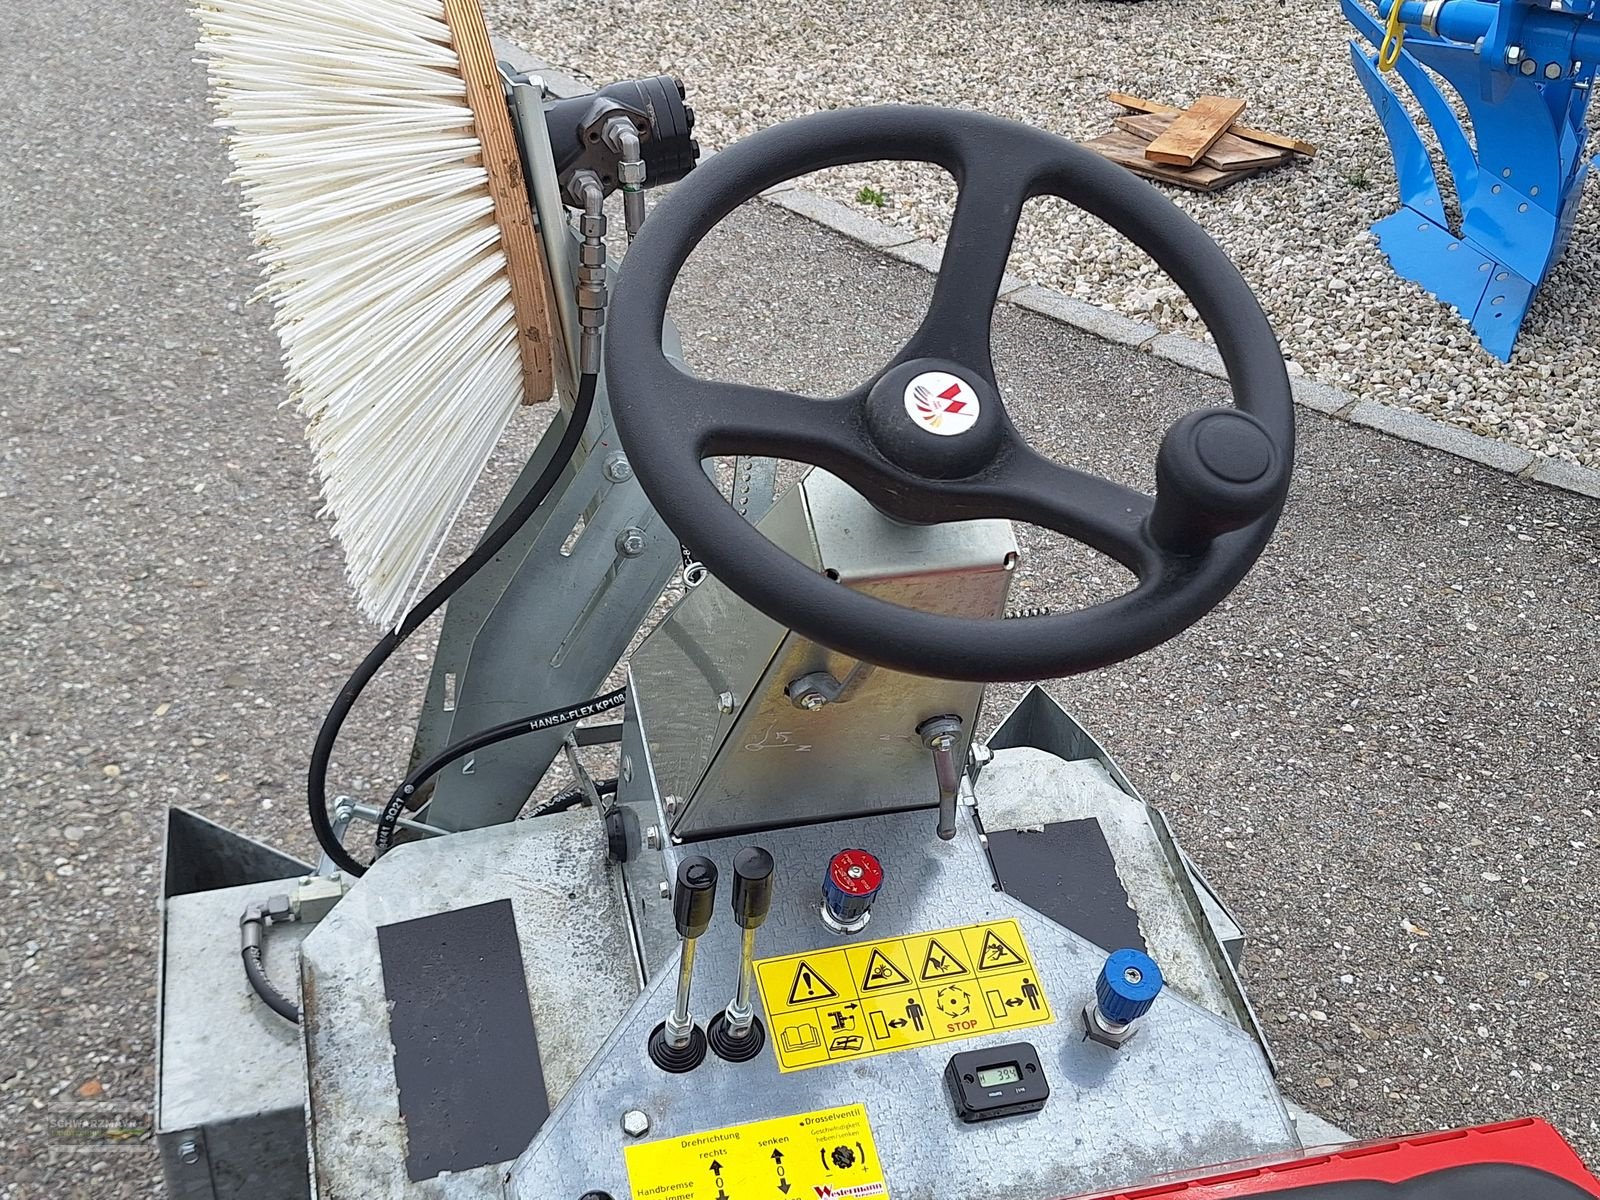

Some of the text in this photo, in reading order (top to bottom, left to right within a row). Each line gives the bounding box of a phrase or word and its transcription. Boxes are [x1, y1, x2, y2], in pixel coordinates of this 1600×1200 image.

[529, 693, 625, 730] HANSA-FLEX KP108
[946, 1019, 978, 1033] STOP
[805, 1108, 861, 1125] Drosselventil
[681, 1131, 741, 1149] Drehrichtung
[757, 1136, 790, 1147] senken
[699, 1148, 728, 1159] rechts
[637, 1181, 694, 1197] Handbremse
[813, 1183, 882, 1200] Westermann
